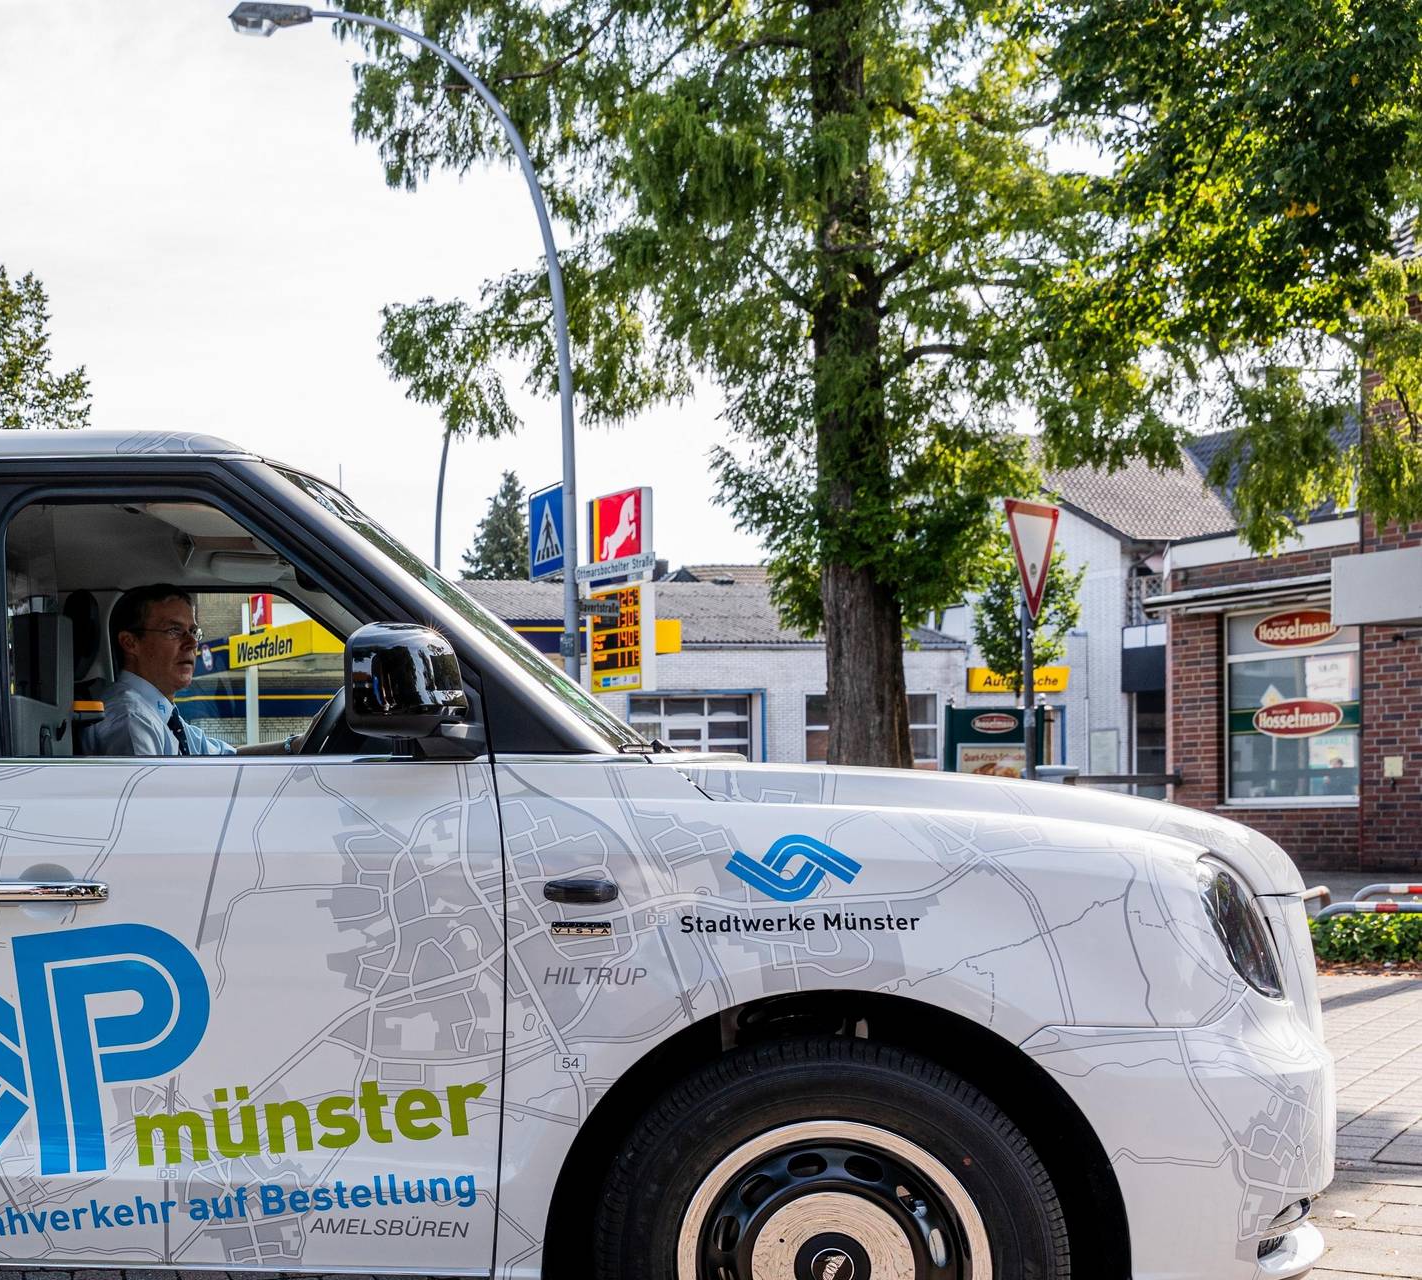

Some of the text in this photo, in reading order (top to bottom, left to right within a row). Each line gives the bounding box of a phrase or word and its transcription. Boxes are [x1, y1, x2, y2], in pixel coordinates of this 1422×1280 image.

[632, 556, 653, 569] Straße
[238, 635, 292, 663] Westfalen
[1258, 706, 1336, 728] Hosselmann
[647, 914, 667, 925] DB
[680, 912, 920, 933] Stadtwerke Münster
[553, 927, 610, 935] VISTA
[543, 966, 647, 985] HILTRUP
[561, 1057, 580, 1069] 54
[134, 1080, 487, 1167] münster
[159, 1168, 177, 1180] DB
[189, 1187, 247, 1221] auf
[259, 1173, 477, 1216] Bestellung
[310, 1216, 469, 1238] AMELSBÜREN
